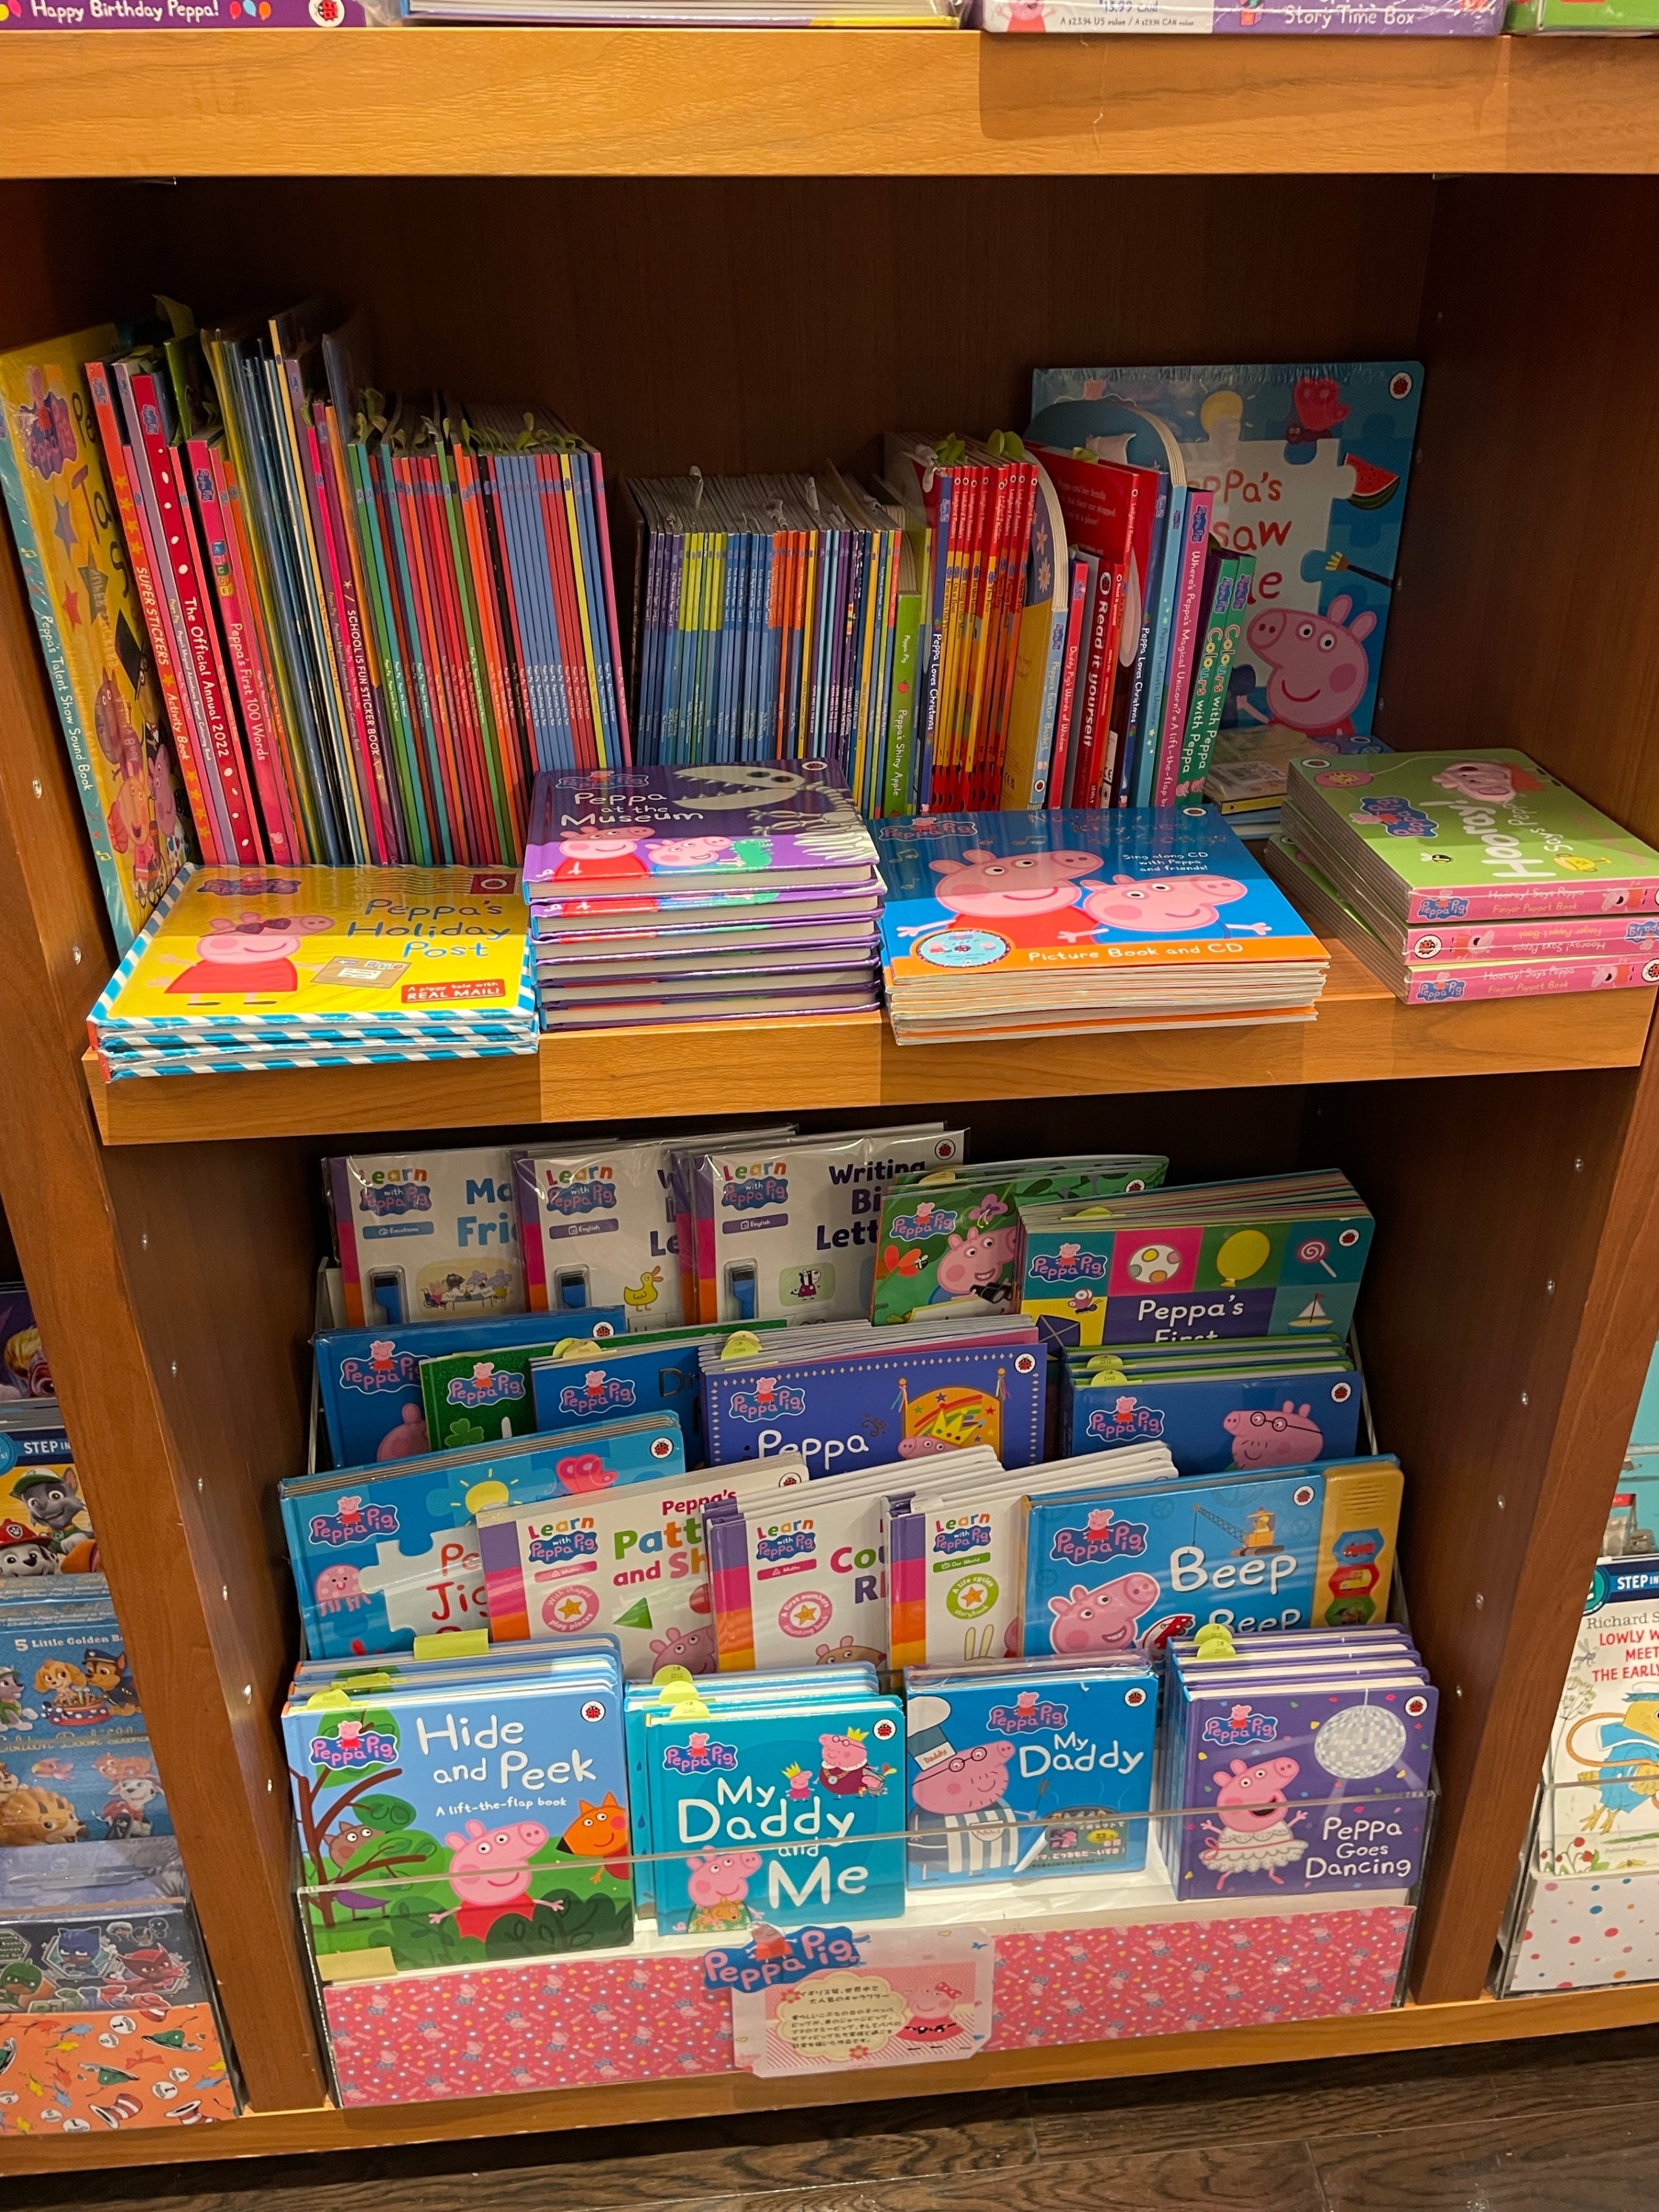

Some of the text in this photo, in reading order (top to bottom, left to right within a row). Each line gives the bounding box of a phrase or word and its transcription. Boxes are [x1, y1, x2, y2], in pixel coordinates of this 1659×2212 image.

[33, 0, 219, 23] Happy Birthday Peppa!
[1285, 5, 1414, 29] Story Time Box
[137, 567, 170, 666] SUPER STICKERS
[184, 596, 197, 622] The
[347, 609, 362, 654] SCHOOL
[1095, 600, 1109, 649] Read
[1172, 550, 1200, 714] Where's Peppa's Magical Unicorn?
[190, 626, 211, 676] Official
[230, 623, 249, 666] Peppa's
[901, 634, 910, 664] Peppa Pig
[355, 655, 364, 664] IS
[1092, 654, 1101, 668] it
[241, 669, 253, 695] First
[356, 665, 368, 685] FUN
[927, 634, 943, 730] Peppa Loves Christmas
[39, 616, 94, 790] Peppa's Talent Show Sound Book
[202, 680, 221, 725] Annual
[246, 699, 261, 721] 100
[360, 686, 375, 726] STICKER
[1041, 661, 1060, 751] Peppa's Easter Basket
[1058, 646, 1078, 753] Daddy Pig's Words of Wisdom
[1082, 672, 1099, 747] yourself
[1182, 627, 1223, 773] Colours with Peppa
[167, 692, 181, 733] Activity
[177, 735, 190, 761] Book
[212, 724, 229, 758] 2022
[252, 723, 269, 761] Words
[367, 728, 380, 756] BOOK
[890, 709, 908, 797] Peppa's Shiny Apple
[1160, 733, 1178, 796] lift-the-flap
[573, 792, 667, 806] Peppa
[601, 804, 668, 814] at the
[559, 810, 704, 827] Museum
[365, 899, 503, 922] Peppa's
[1492, 902, 1578, 914] Finger Puppet Book
[347, 921, 511, 940] Holiday
[402, 941, 489, 958] Post
[1028, 941, 1244, 962] Picture Book and CD
[406, 990, 449, 1001] REAL
[1488, 981, 1568, 995] Finger Puppet Book
[749, 1218, 771, 1228] English
[1138, 1294, 1244, 1327] Peppa's
[24, 1440, 58, 1454] STEP
[528, 1517, 595, 1541] Learn
[613, 1560, 662, 1588] and
[1170, 1546, 1298, 1595] Beep
[1617, 1574, 1648, 1590] STEP
[547, 1586, 594, 1605] With shaped
[548, 1613, 594, 1631] play pieces
[1587, 1613, 1648, 1630] Richard
[15, 1636, 109, 1652] 5 Little Golden
[1599, 1630, 1644, 1646] LOWLY
[1592, 1668, 1618, 1682] THE
[416, 1713, 525, 1755] Hide
[1054, 1730, 1089, 1751] My
[313, 1735, 393, 1766] Peppa Pig
[923, 1747, 947, 1763] Daddy
[1019, 1740, 1145, 1778] Daddy
[433, 1749, 597, 1791] and Peek
[716, 1775, 776, 1808] My
[435, 1796, 567, 1817] A lift-the-flap book
[678, 1796, 855, 1847] Daddy
[1321, 1816, 1403, 1841] Peppa
[778, 1837, 819, 1858] and
[1336, 1842, 1389, 1859] Goes
[1305, 1856, 1412, 1879] Dancing
[768, 1856, 869, 1909] Me
[704, 1930, 853, 1990] Peppa Pig
